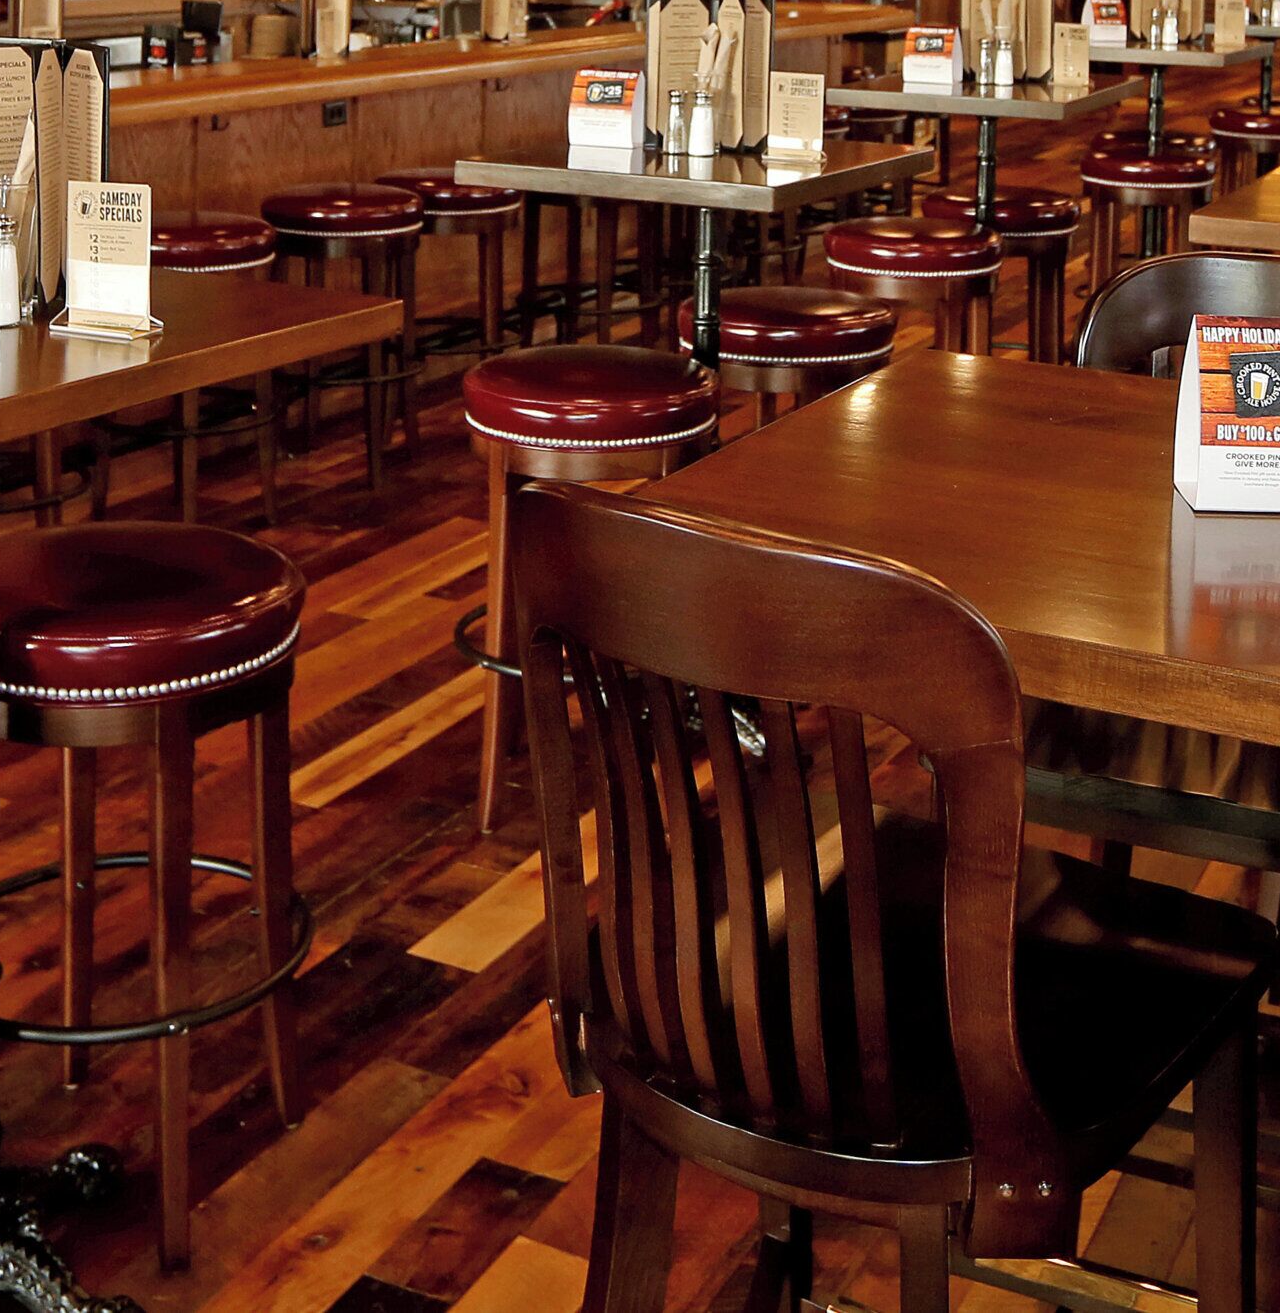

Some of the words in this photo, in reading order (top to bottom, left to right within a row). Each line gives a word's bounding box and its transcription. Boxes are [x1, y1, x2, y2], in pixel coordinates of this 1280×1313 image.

[100, 192, 142, 206] GAMEDAY
[100, 207, 142, 222] SPECIALS
[90, 234, 98, 243] $2
[90, 245, 98, 254] $3
[1202, 327, 1241, 343] HAPPY
[1236, 362, 1262, 395] CROOKED
[1262, 364, 1280, 383] PINT
[1245, 397, 1259, 407] ALE
[1217, 424, 1239, 440] BUY
[1240, 426, 1265, 441] $100
[1266, 431, 1272, 442] &
[1256, 461, 1280, 469] MORE.
